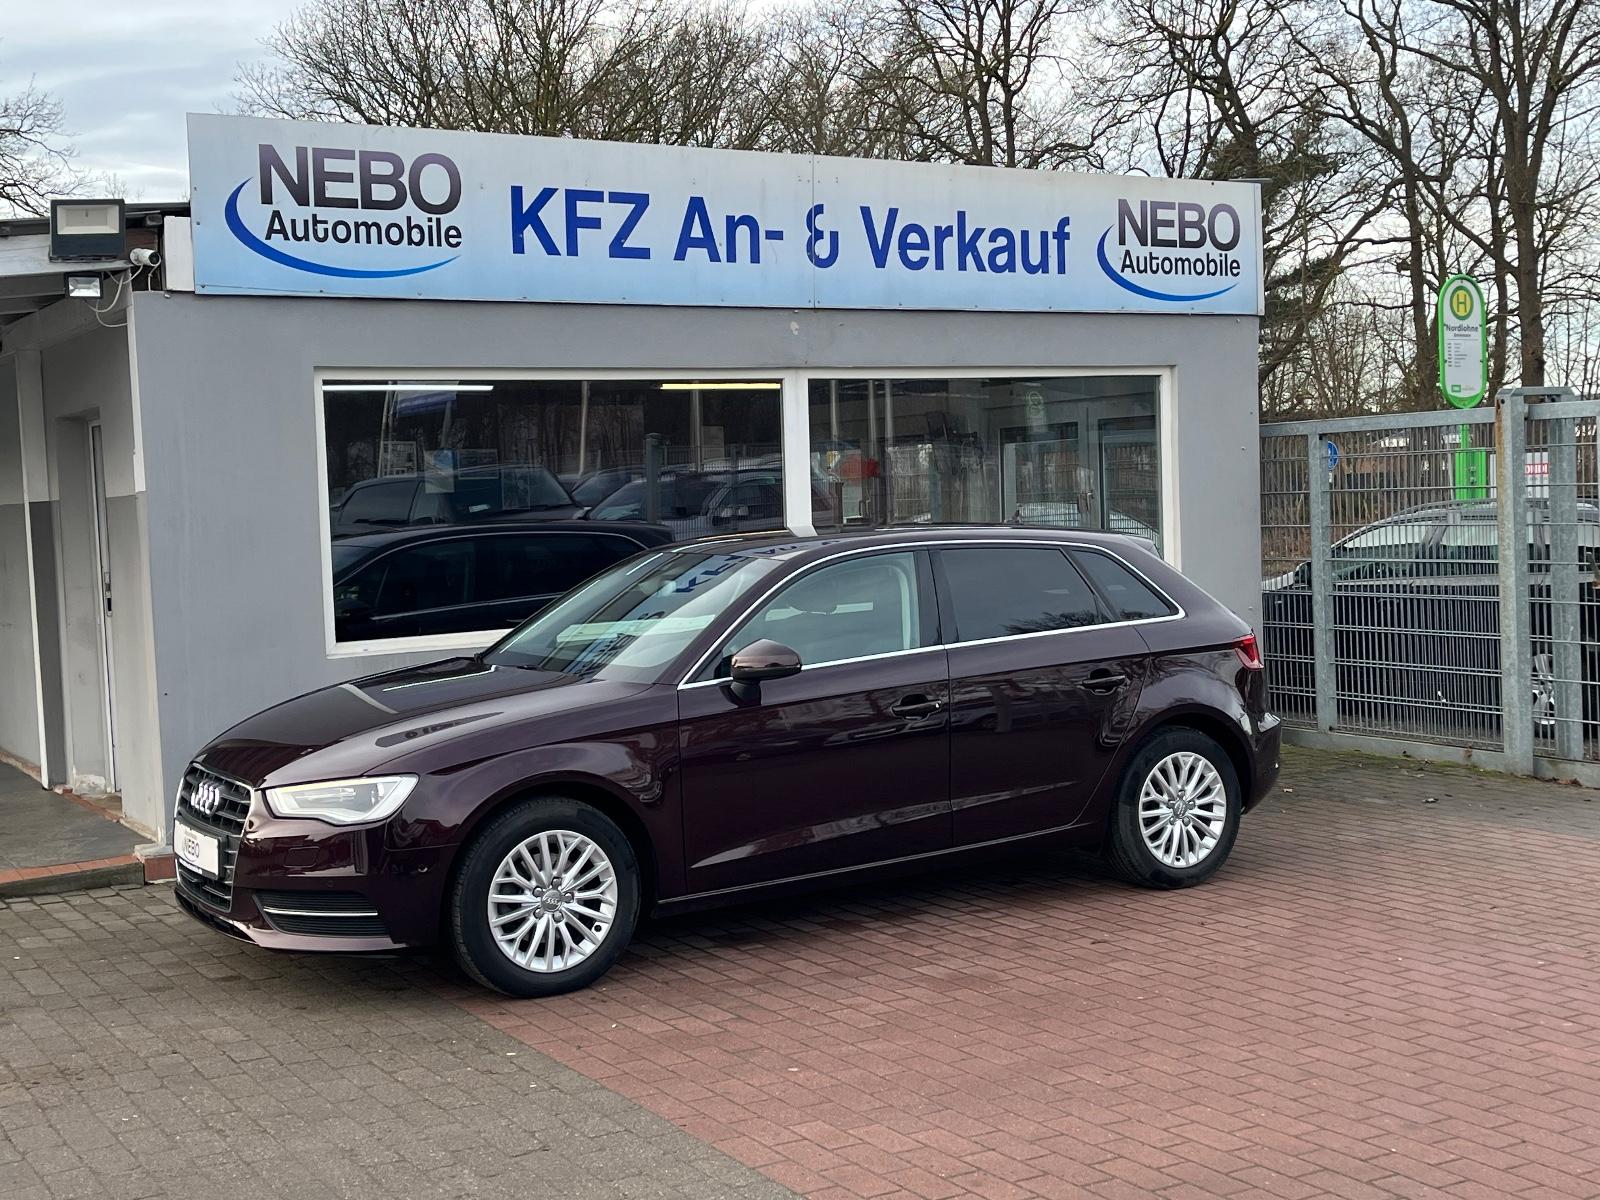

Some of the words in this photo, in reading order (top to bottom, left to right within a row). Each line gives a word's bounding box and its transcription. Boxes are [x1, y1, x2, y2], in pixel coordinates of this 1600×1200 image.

[259, 143, 462, 215] NEBO
[265, 209, 462, 248] Automobile
[510, 185, 651, 260] KFZ
[673, 196, 784, 264] An-
[806, 203, 840, 268] &
[859, 206, 1071, 275] Verkauf
[1117, 198, 1241, 252] NEBO
[1120, 248, 1241, 277] Automobile
[1446, 324, 1478, 332] Nordlohne
